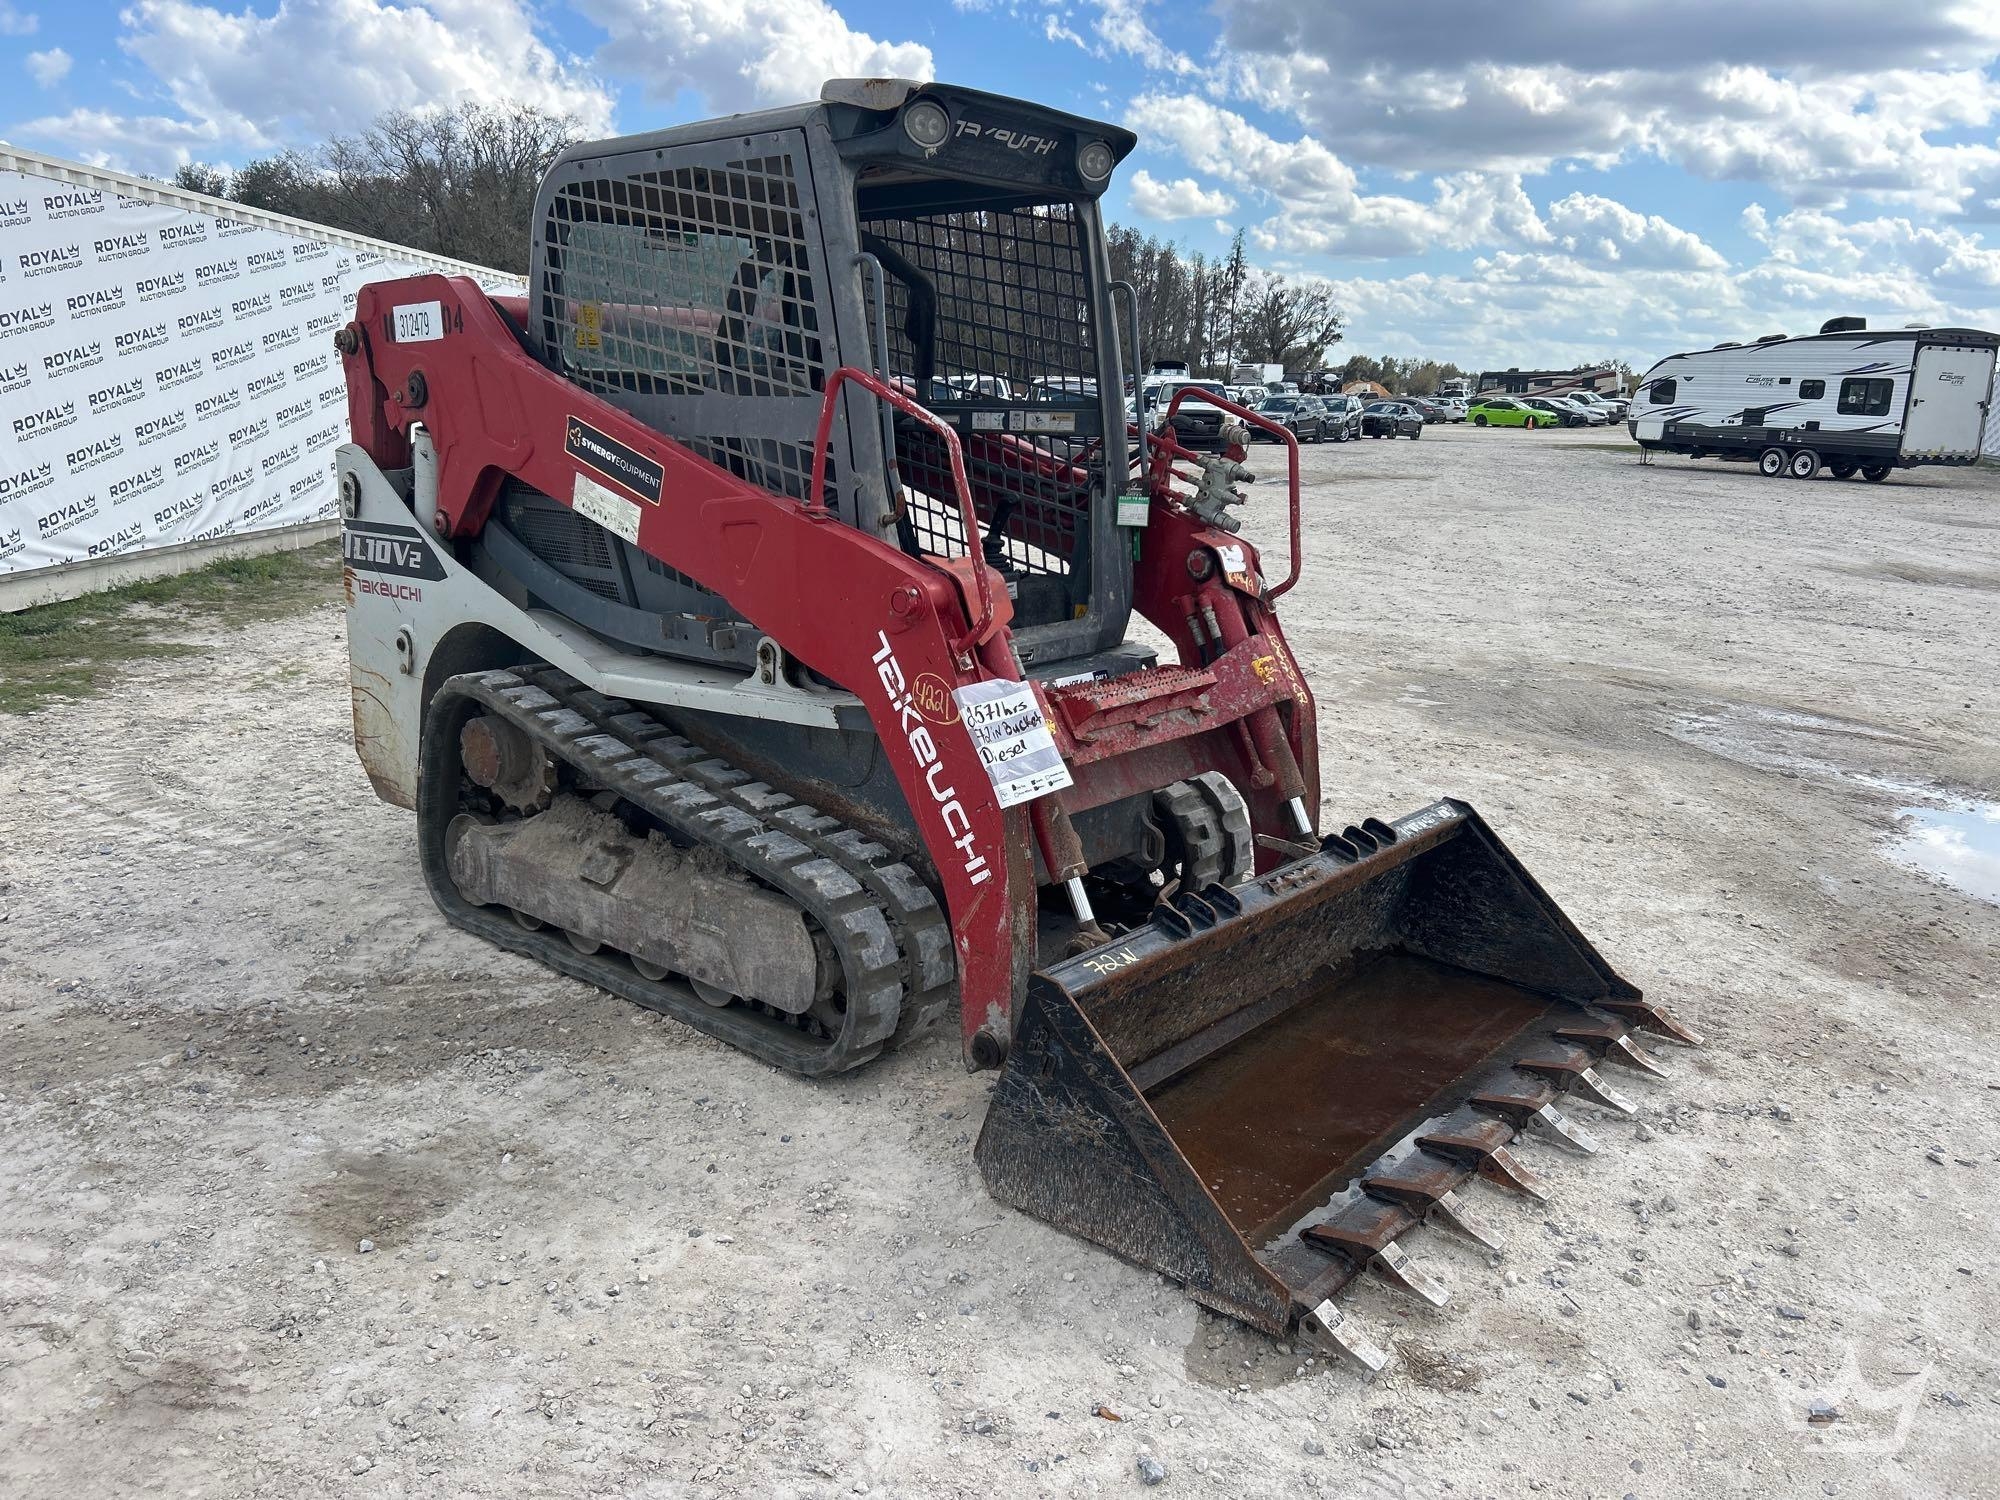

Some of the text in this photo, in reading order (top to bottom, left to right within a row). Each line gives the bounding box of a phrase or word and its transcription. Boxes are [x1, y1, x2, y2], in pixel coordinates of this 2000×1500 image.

[44, 192, 91, 210] ROYAL
[4, 216, 32, 228] GROUP
[48, 206, 104, 220] AUCTION GROUP
[159, 224, 196, 241] ROYAL
[163, 235, 207, 250] AUCTION GROUP
[94, 235, 138, 254] ROYAL
[98, 246, 150, 263] AUCTION GROUP
[293, 242, 320, 255] ROYAL
[19, 248, 68, 268] ROYAL
[247, 251, 277, 266] ROYAL
[250, 261, 286, 274] AUCTION GROUP
[24, 260, 82, 278] AUCTION GROUP
[195, 262, 229, 279] ROYAL
[136, 275, 176, 294] ROYAL
[198, 272, 240, 287] AUCTION GROUP
[66, 290, 112, 310] ROYAL
[140, 286, 187, 303] AUCTION GROUP
[280, 283, 308, 299] ROYAL
[282, 293, 316, 307] AUCTION GROUP
[70, 300, 126, 320] AUCTION GROUP
[232, 296, 263, 313] ROYAL
[235, 305, 272, 321] AUCTION GROUP
[0, 307, 40, 327] OYAL
[29, 319, 55, 331] GROUP
[178, 310, 213, 329] ROYAL
[307, 316, 332, 330] ROYAL
[400, 311, 430, 338] 312479
[115, 327, 157, 348] ROYAL
[181, 320, 224, 338] AUCTION GROUP
[262, 328, 292, 346] ROYAL
[118, 337, 169, 357] AUCTION GROUP
[212, 344, 246, 363] ROYAL
[265, 337, 300, 354] AUCTION GROUP
[43, 346, 90, 369] ROYAL
[48, 356, 104, 379] AUCTION GROUP
[215, 352, 255, 371] AUCTION GROUP
[294, 357, 320, 375] ROYAL
[156, 362, 193, 383] ROYAL
[159, 371, 203, 392] AUCTION GROUP
[296, 365, 328, 382] AUCTION GROUP
[3, 379, 31, 393] GROUP
[247, 374, 278, 393] ROYAL
[250, 382, 286, 401] AUCTION GROUP
[88, 382, 132, 406] ROYAL
[92, 392, 146, 415] AUCTION GROUP
[195, 393, 230, 414] ROYAL
[13, 407, 64, 433] ROYAL
[198, 401, 241, 421] AUCTION GROUP
[276, 403, 305, 422] ROYAL
[279, 410, 314, 429] AUCTION GROUP
[18, 416, 78, 443] AUCTION GROUP
[135, 415, 175, 438] ROYAL
[139, 422, 187, 447] AUCTION GROUP
[229, 422, 261, 444] ROYAL
[306, 429, 332, 447] ROYAL
[66, 440, 111, 466] ROYAL
[70, 448, 124, 475] AUCTION GROUP
[174, 446, 210, 469] ROYAL
[262, 449, 291, 469] ROYAL
[177, 453, 220, 477] AUCTION GROUP
[265, 455, 300, 477] AUCTION GROUP
[0, 469, 39, 493] OYAL
[28, 477, 54, 492] GROUP
[109, 472, 152, 497] ROYAL
[211, 472, 246, 495] ROYAL
[215, 478, 254, 503] AUCTION GROUP
[290, 474, 317, 495] ROYAL
[113, 479, 164, 506] AUCTION GROUP
[38, 502, 85, 531] ROYAL
[154, 498, 195, 524] ROYAL
[243, 498, 274, 520] ROYAL
[41, 509, 99, 540] AUCTION GROUP
[159, 515, 185, 532] AUCTION
[88, 529, 132, 557] ROYAL
[916, 681, 950, 720] 4221
[980, 739, 1027, 764] Diesel
